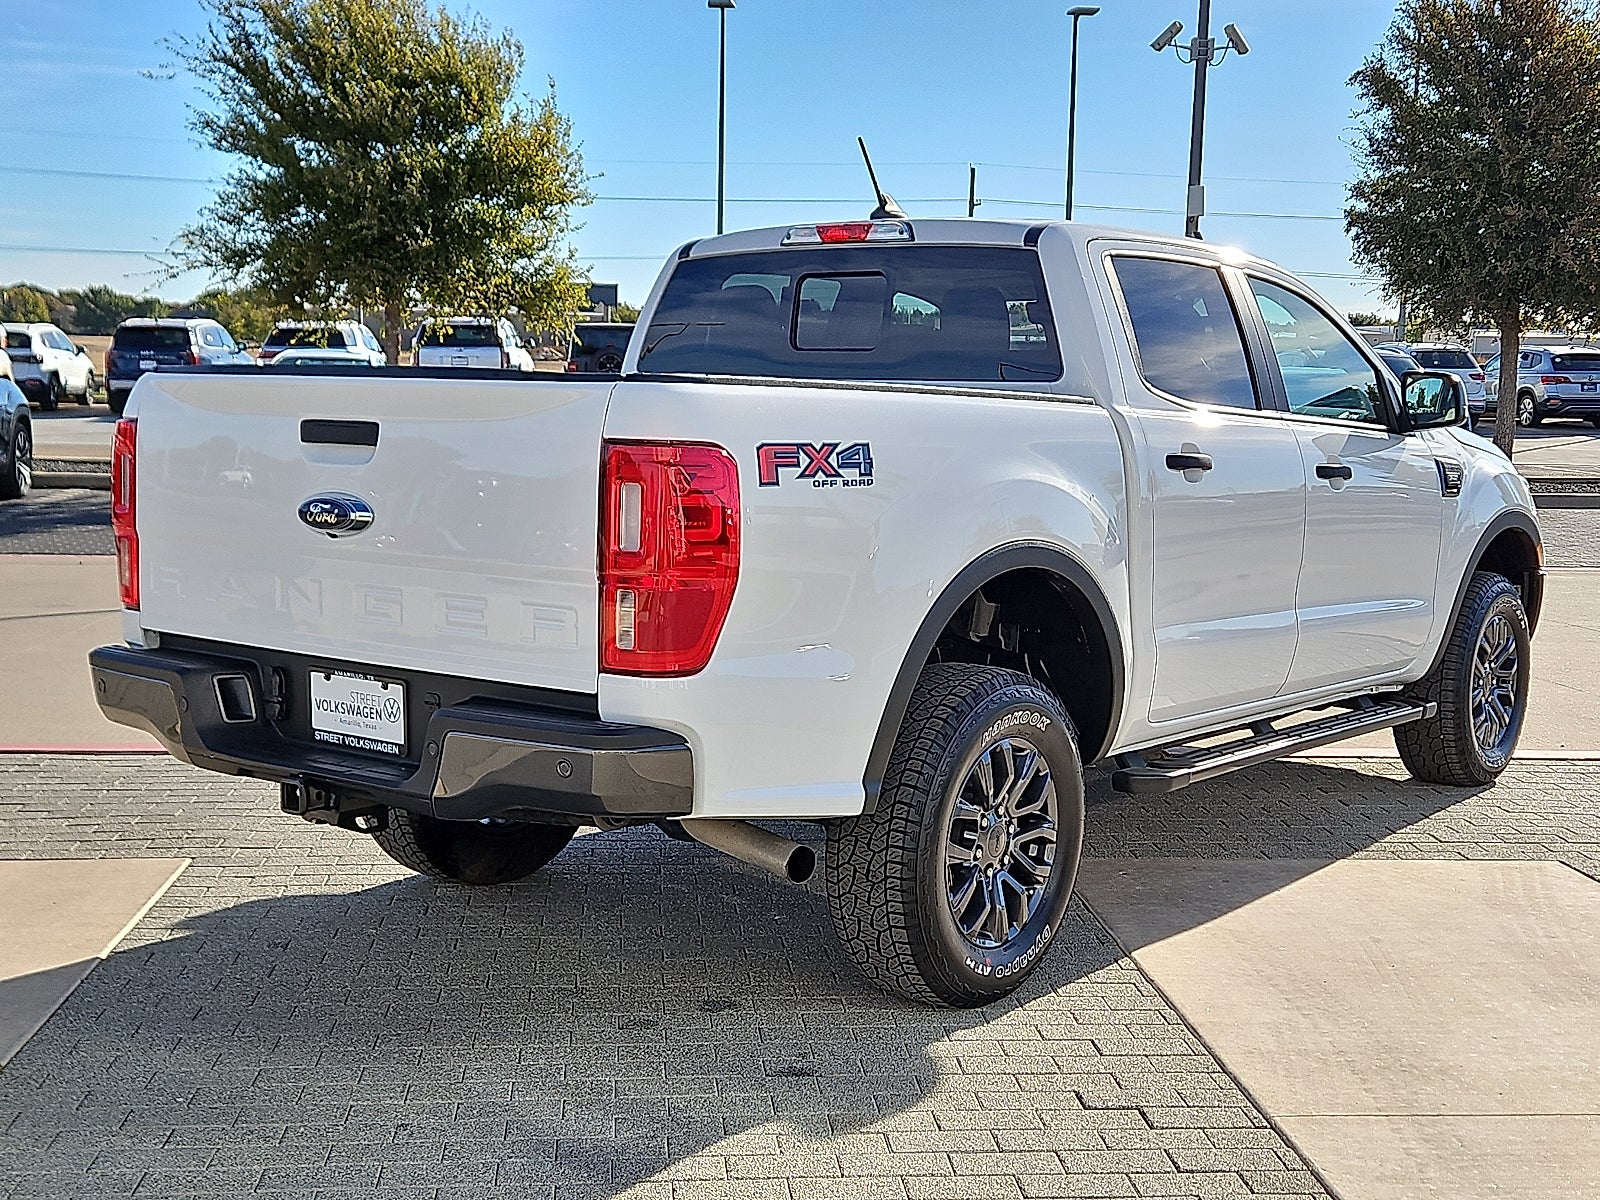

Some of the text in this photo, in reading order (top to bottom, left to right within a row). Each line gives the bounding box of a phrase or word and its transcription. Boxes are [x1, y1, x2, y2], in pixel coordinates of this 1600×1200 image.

[756, 441, 874, 487] FX4
[812, 478, 874, 488] OFF ROAD
[306, 502, 338, 524] Ford
[147, 560, 580, 650] RANGER
[314, 697, 383, 721] VOLKSWAGEN
[350, 690, 382, 707] STREET
[314, 730, 400, 755] STREET VOLKSWAGEN
